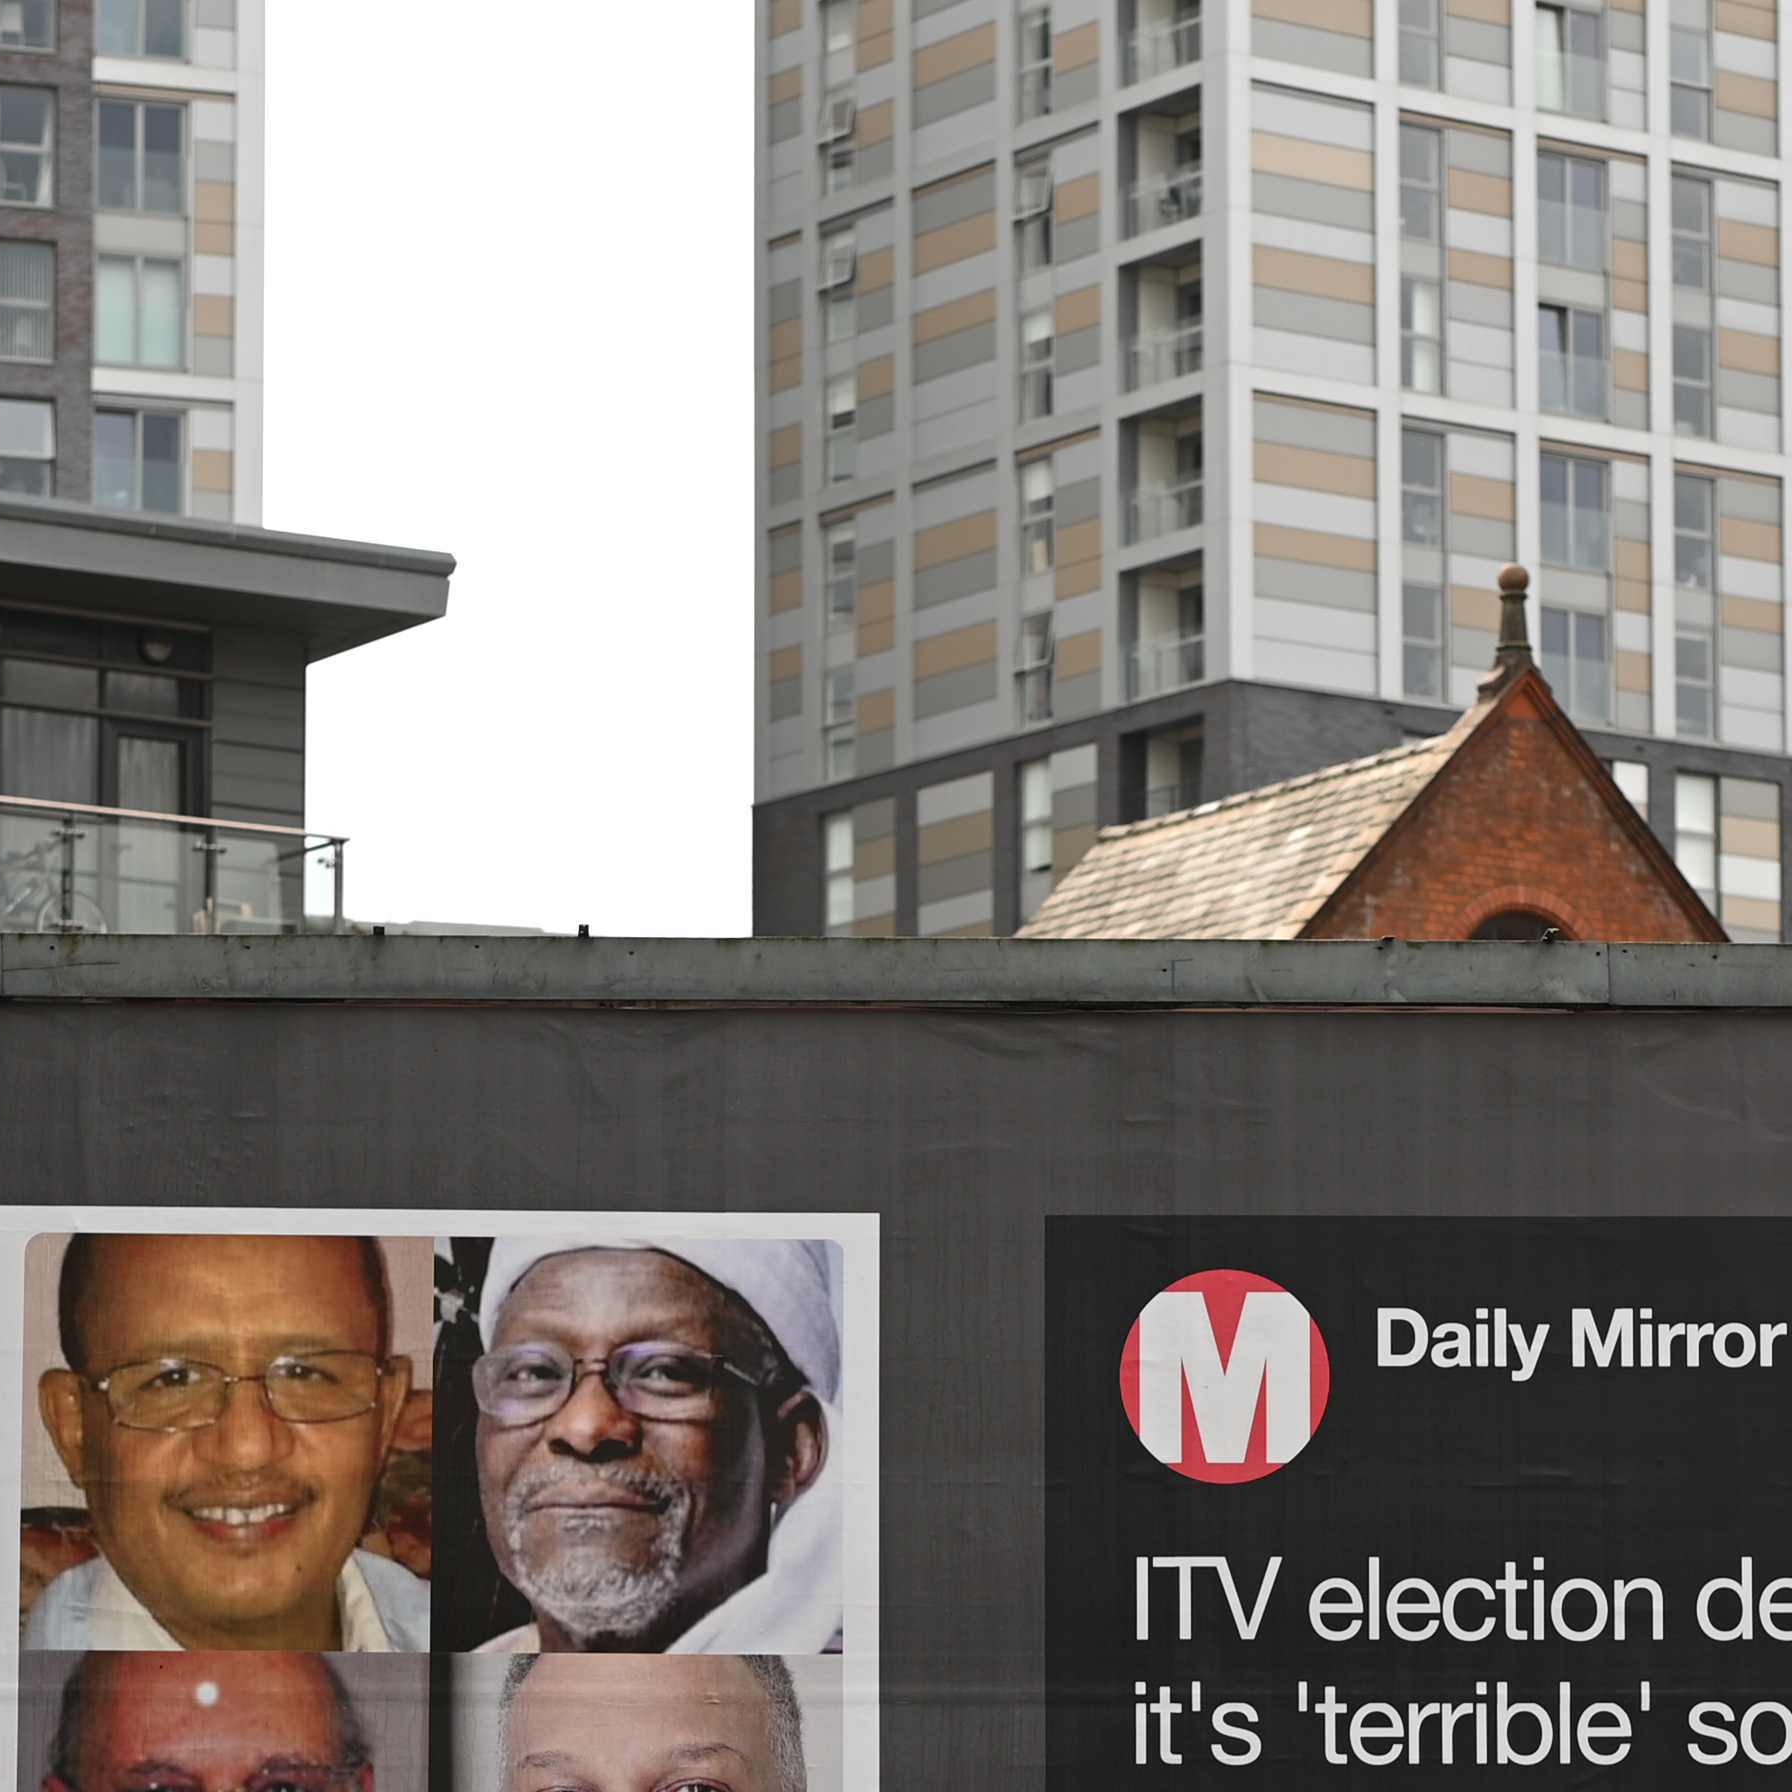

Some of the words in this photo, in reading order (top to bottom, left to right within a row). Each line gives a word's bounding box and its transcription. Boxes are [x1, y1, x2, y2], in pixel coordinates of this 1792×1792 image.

[1377, 1307, 1550, 1381] Daily
[1571, 1307, 1788, 1368] Mirror
[1136, 1556, 1284, 1641] ITV
[1308, 1556, 1665, 1643] election
[1135, 1680, 1263, 1766] it's
[1297, 1680, 1652, 1766] 'terrible'
